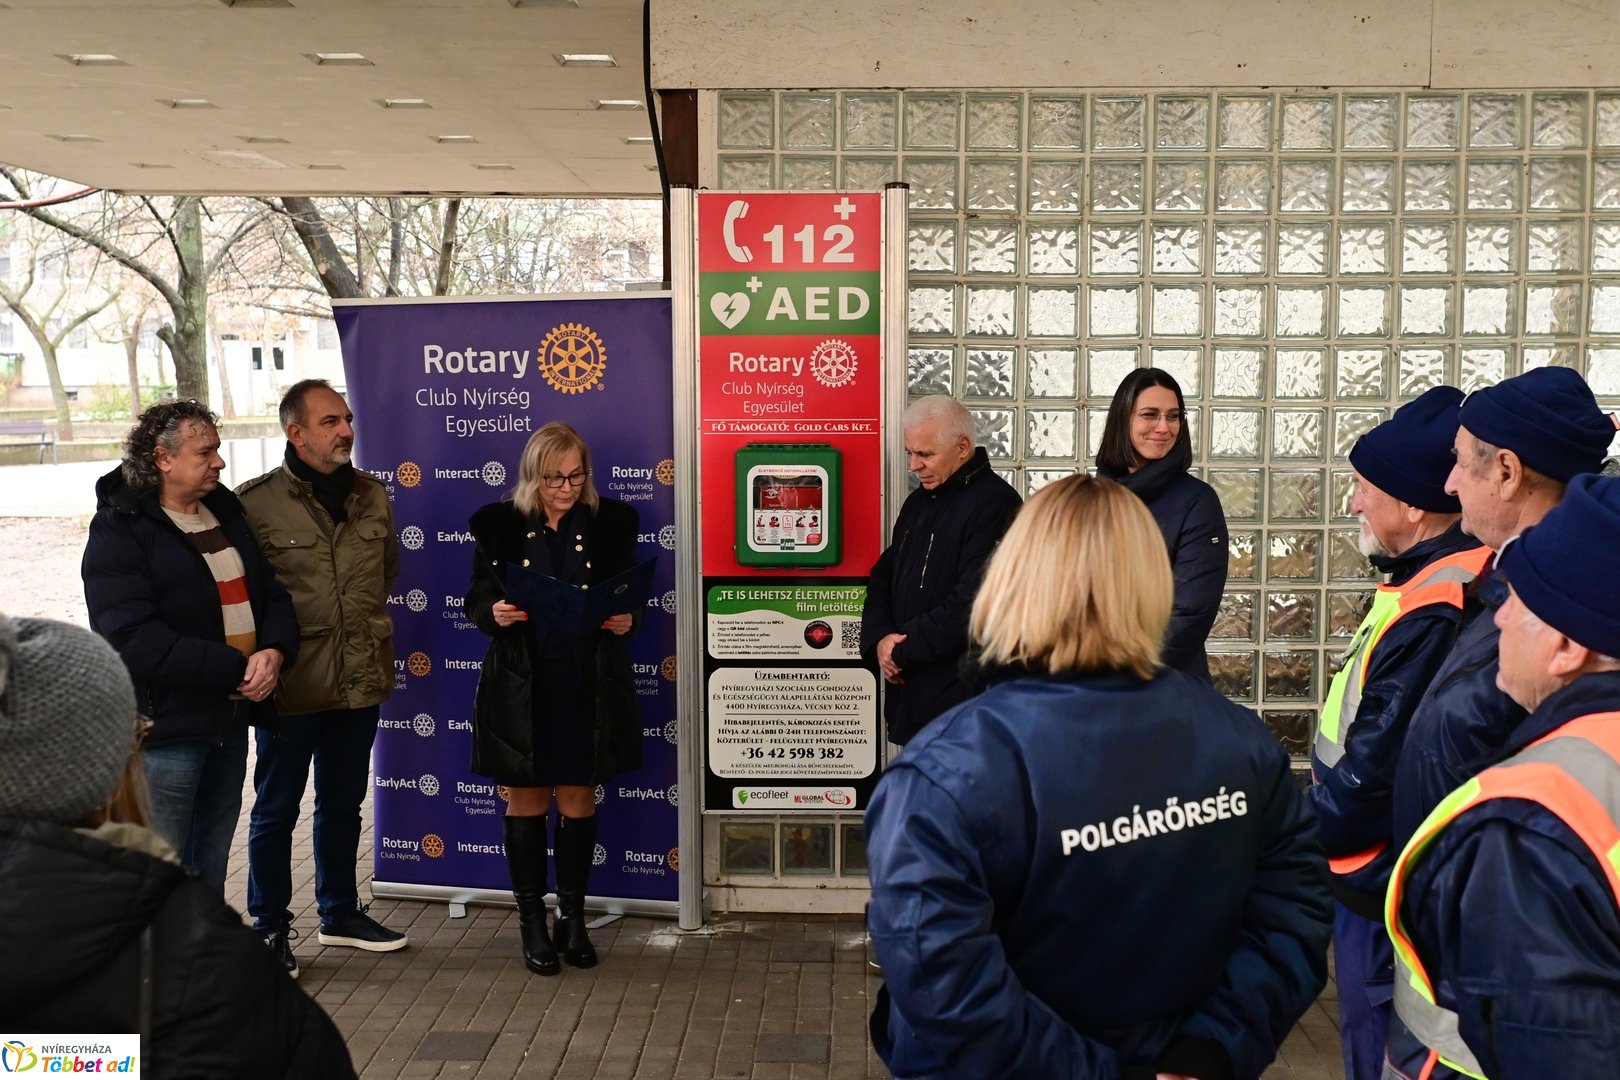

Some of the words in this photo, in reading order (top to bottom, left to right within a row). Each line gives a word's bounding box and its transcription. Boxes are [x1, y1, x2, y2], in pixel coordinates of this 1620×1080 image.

[763, 224, 854, 263] 112
[766, 287, 870, 320] AED
[557, 330, 586, 340] ROTARY
[424, 344, 530, 378] Rotary
[730, 352, 804, 376] Rotary
[549, 368, 598, 386] INTERNATIONAL
[722, 382, 752, 396] Club
[756, 382, 804, 398] Nyírség
[416, 388, 456, 406] Club
[464, 387, 530, 410] Nyírség
[743, 400, 804, 416] Egyesület
[446, 414, 532, 437] Egyesület
[712, 422, 726, 431] FŐ
[730, 422, 789, 431] TÁMOGATÓ:
[360, 468, 394, 482] tary
[435, 468, 480, 479] Interact
[612, 466, 652, 480] Rotary
[627, 482, 653, 491] Nyírség
[620, 492, 654, 501] Egyesület
[437, 531, 476, 544] EarlyA
[716, 590, 734, 602] „TE
[736, 590, 746, 600] IS
[749, 590, 792, 600] LEHETSZ
[796, 602, 817, 612] film
[445, 659, 482, 669] Interac
[632, 663, 658, 675] tary
[754, 671, 830, 680] ÜZEMBENTARTÓ:
[448, 720, 473, 732] Early
[741, 747, 764, 759] +36
[768, 748, 785, 758] 42
[790, 748, 815, 759] 598
[818, 748, 844, 759] 382
[376, 776, 417, 789] EarlyAct
[457, 782, 494, 795] Rotary
[619, 788, 665, 800] EarlyAct
[750, 790, 788, 799] ecofleet
[471, 798, 495, 806] Nyírség
[465, 806, 496, 815] Egyesület
[1060, 786, 1248, 856] POLGÁRŐRSÉG
[382, 837, 419, 850] Rotary
[458, 842, 499, 854] Interact
[397, 853, 420, 862] Nyírség
[625, 851, 665, 865] Rotary
[640, 866, 665, 876] Nyírség
